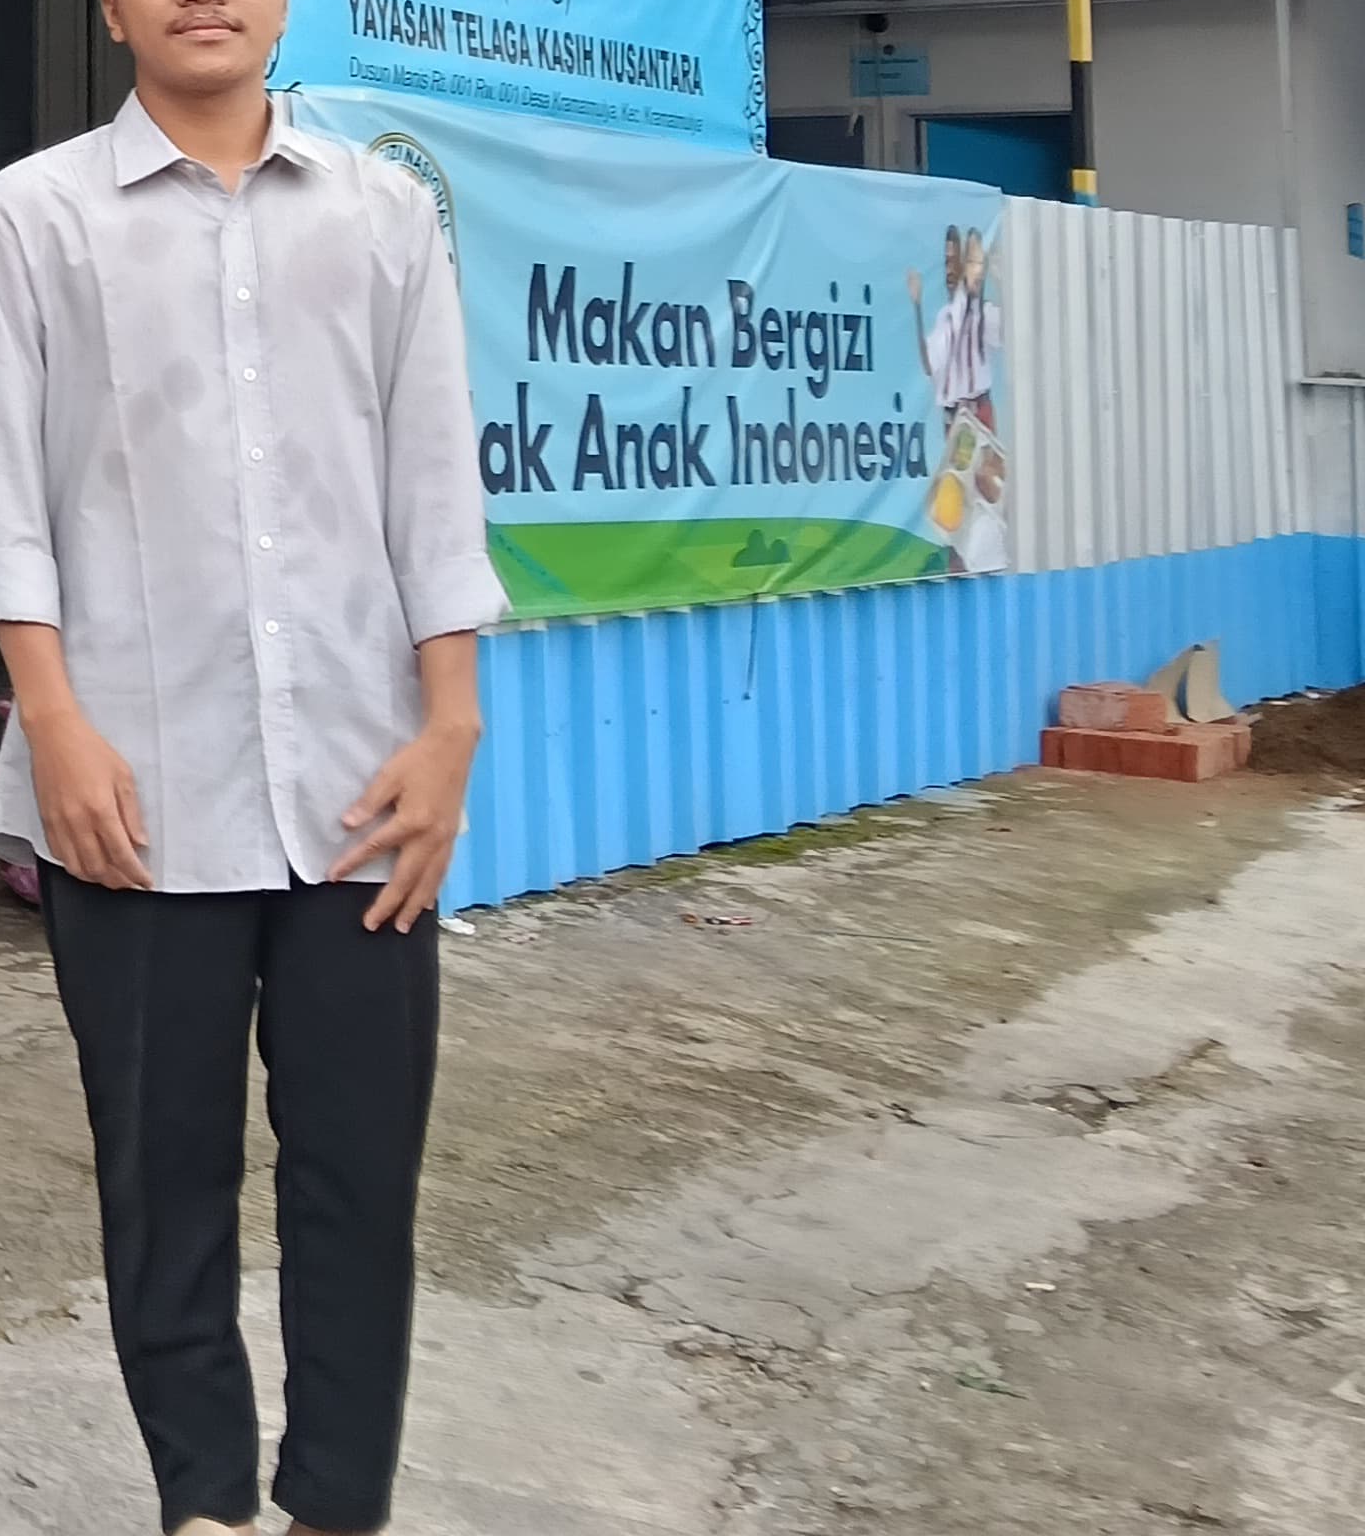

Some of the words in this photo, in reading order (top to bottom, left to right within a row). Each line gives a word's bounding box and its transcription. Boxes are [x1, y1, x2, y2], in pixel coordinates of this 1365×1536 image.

[350, 56, 391, 83] Dusun
[450, 74, 472, 97] 001
[499, 82, 519, 104] 001
[451, 10, 531, 68] TELAGA
[536, 28, 594, 78] KASIH
[600, 37, 704, 96] NUSANTARA
[527, 262, 717, 368] Makan
[726, 279, 875, 399] Bergizi
[473, 382, 557, 495] ak
[573, 386, 717, 491] Anak
[726, 387, 928, 485] Indonesia
